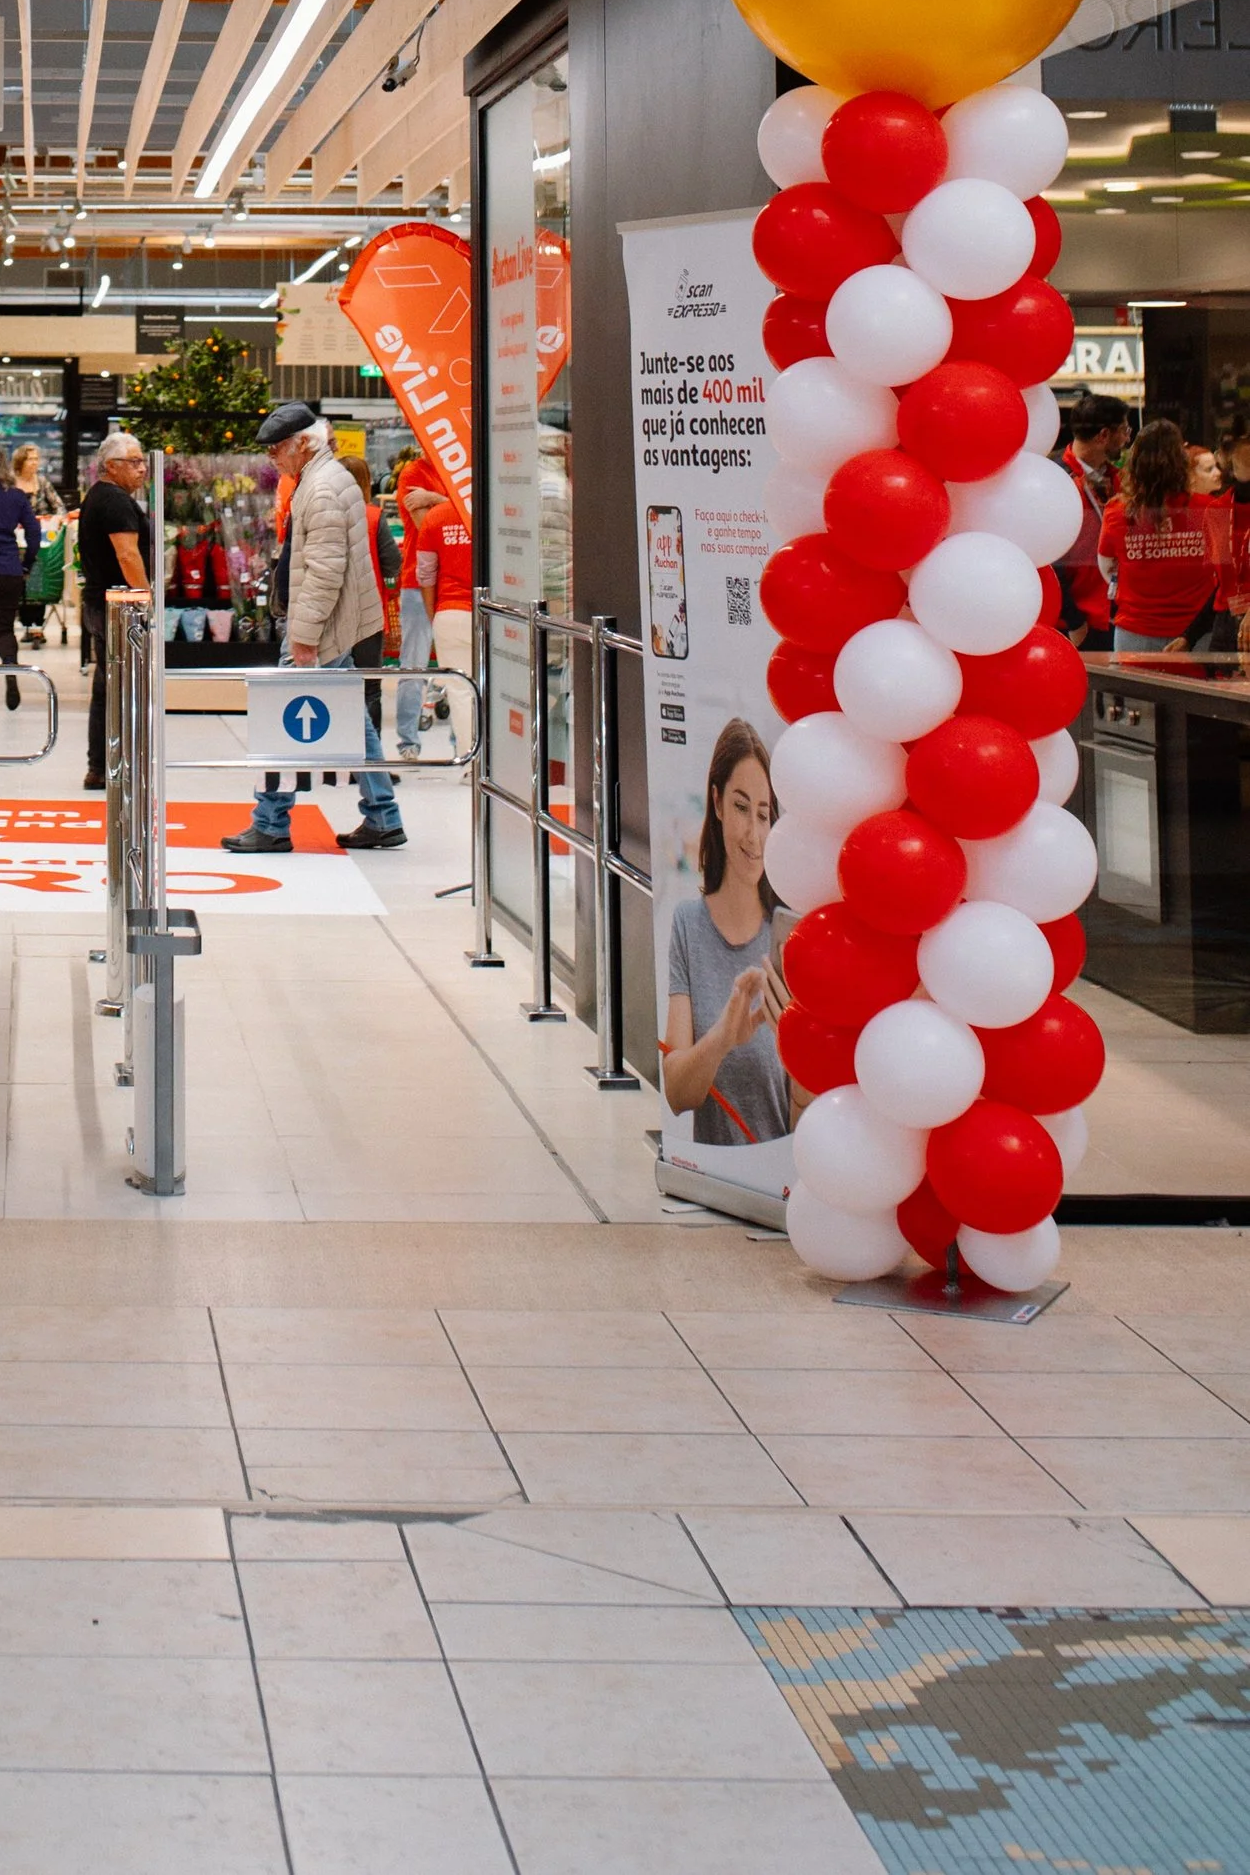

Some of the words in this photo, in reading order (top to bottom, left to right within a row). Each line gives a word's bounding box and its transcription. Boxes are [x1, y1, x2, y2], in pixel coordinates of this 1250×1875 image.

[492, 246, 517, 288] Auchan
[517, 236, 533, 280] Live
[687, 283, 713, 298] scan
[673, 302, 720, 318] EXPRESSO
[640, 352, 704, 375] Junte-se
[709, 353, 734, 372] aos
[641, 380, 674, 405] mais
[678, 379, 698, 404] de
[702, 379, 733, 404] 400
[736, 377, 766, 403] mil
[642, 416, 666, 442] que
[669, 410, 685, 442] já
[644, 447, 659, 466] as
[662, 443, 752, 474] vantagens:
[695, 509, 714, 524] Faça
[716, 511, 732, 525] aqui
[734, 513, 738, 522] o
[739, 510, 768, 523] check-i
[707, 527, 712, 536] e
[714, 526, 736, 540] ganhe
[737, 528, 762, 541] tempo
[656, 535, 672, 556] app
[701, 543, 716, 553] nas
[717, 544, 734, 554] suas
[736, 543, 769, 557] compras!
[1127, 549, 1143, 560] OS
[1145, 546, 1205, 560] SORRISOS
[654, 556, 678, 569] Auchan
